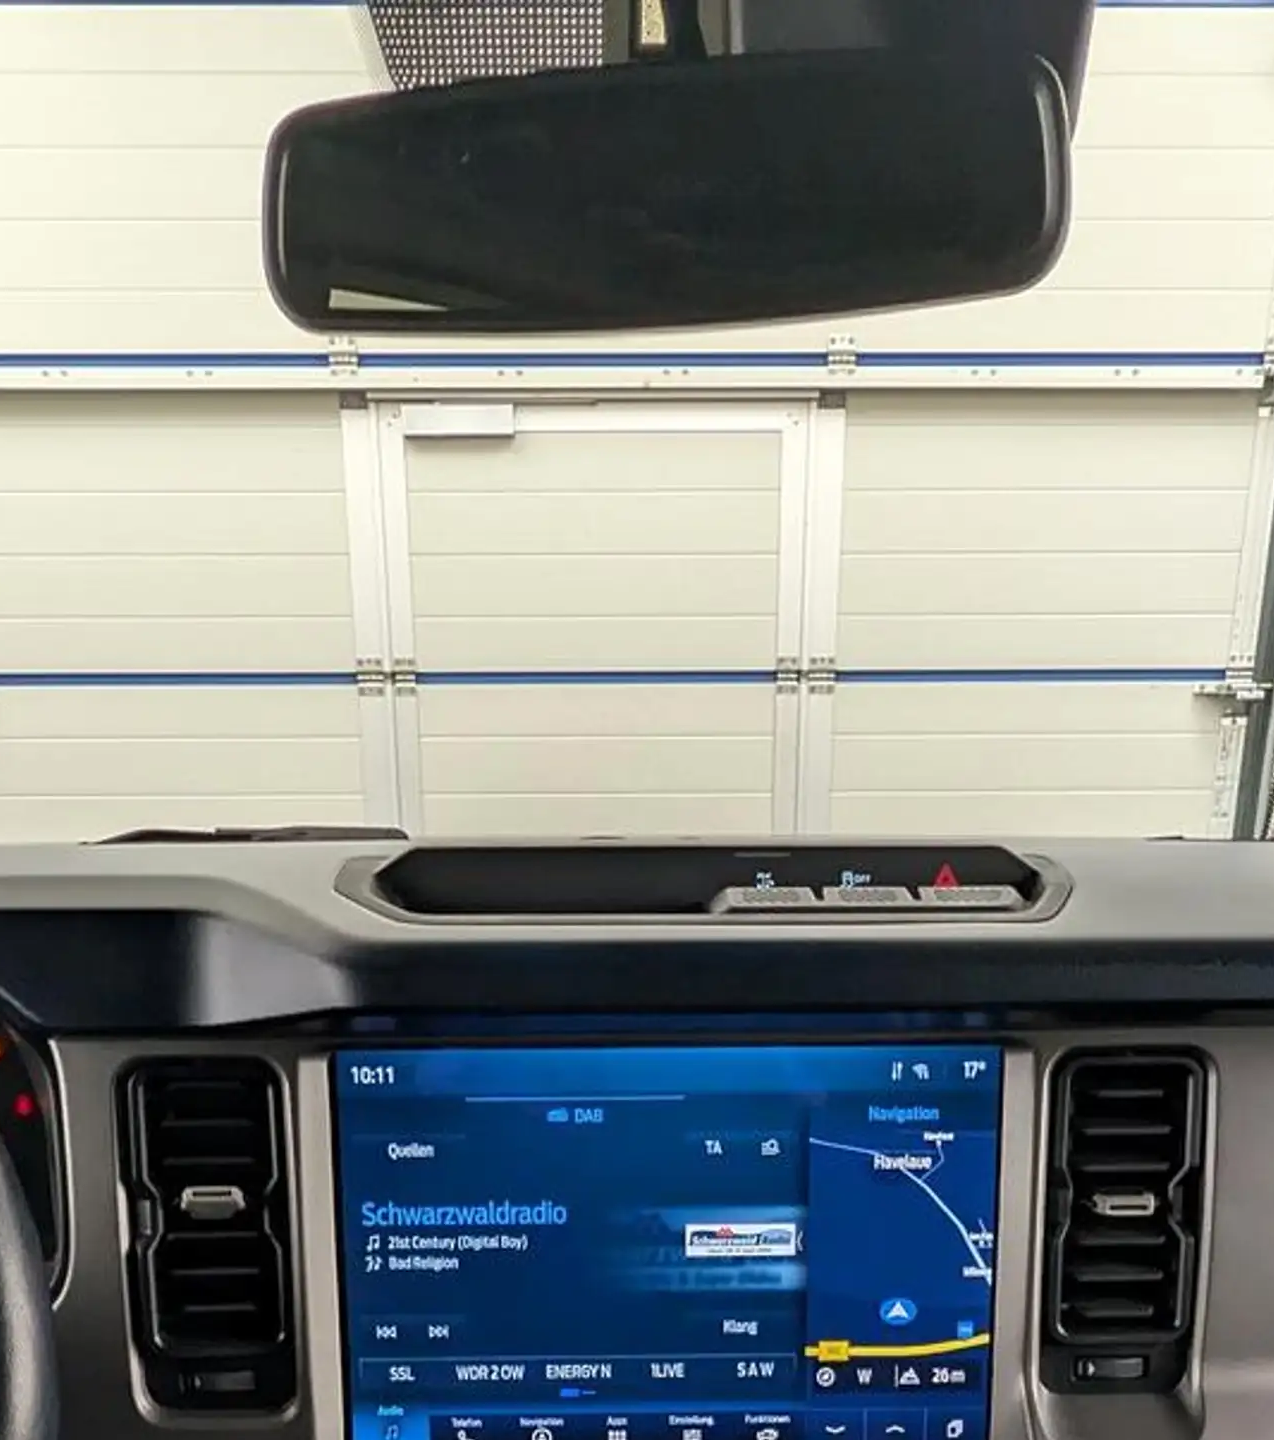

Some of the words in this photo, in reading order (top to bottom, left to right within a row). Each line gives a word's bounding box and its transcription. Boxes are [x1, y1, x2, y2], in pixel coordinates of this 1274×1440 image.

[350, 1066, 395, 1085] 10:11
[574, 1108, 604, 1123] DAB
[868, 1105, 940, 1123] Navigation
[388, 1143, 435, 1160] Quellen
[705, 1140, 723, 1155] TA
[361, 1200, 568, 1228] Schwarzwaldradio
[388, 1236, 410, 1249] 21st
[412, 1236, 456, 1251] Century
[458, 1235, 499, 1251] (Digital
[501, 1235, 528, 1251] Boy)
[388, 1256, 411, 1270] Bad
[412, 1256, 459, 1272] Religion
[723, 1319, 759, 1336] Klang
[389, 1366, 416, 1382] SSL
[455, 1364, 489, 1381] WDR
[545, 1364, 599, 1381] ENERGY
[856, 1368, 873, 1385] W
[520, 1416, 565, 1428] Navigation
